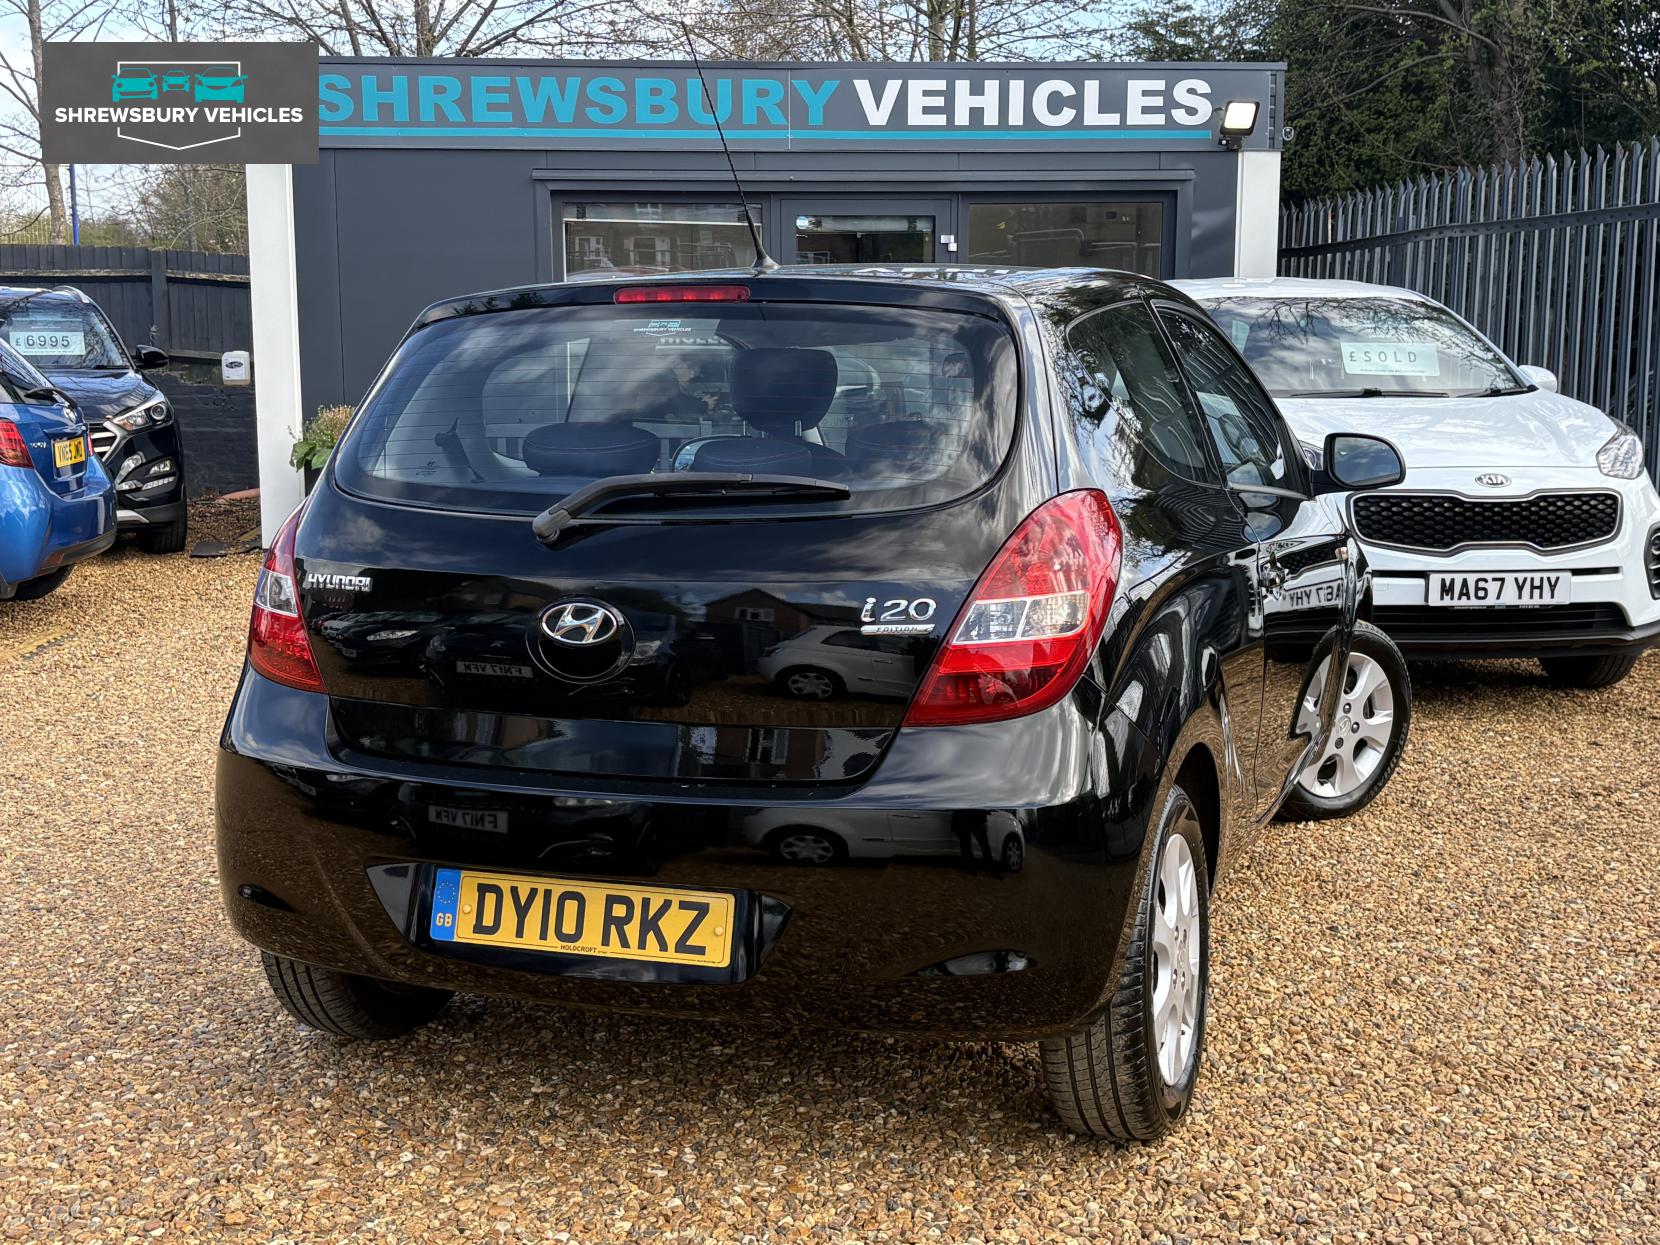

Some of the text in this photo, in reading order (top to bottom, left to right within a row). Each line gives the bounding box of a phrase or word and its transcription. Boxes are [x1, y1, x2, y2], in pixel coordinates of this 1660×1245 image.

[319, 74, 1212, 126] SHREWSBURY VEHICLES
[303, 573, 372, 592] HYUNDAI
[1440, 576, 1560, 601] MA67 YHY
[861, 598, 937, 622] i20
[436, 912, 452, 927] GB
[472, 882, 710, 956] DY10 RKZ
[560, 943, 598, 954] HOLDCROFT
